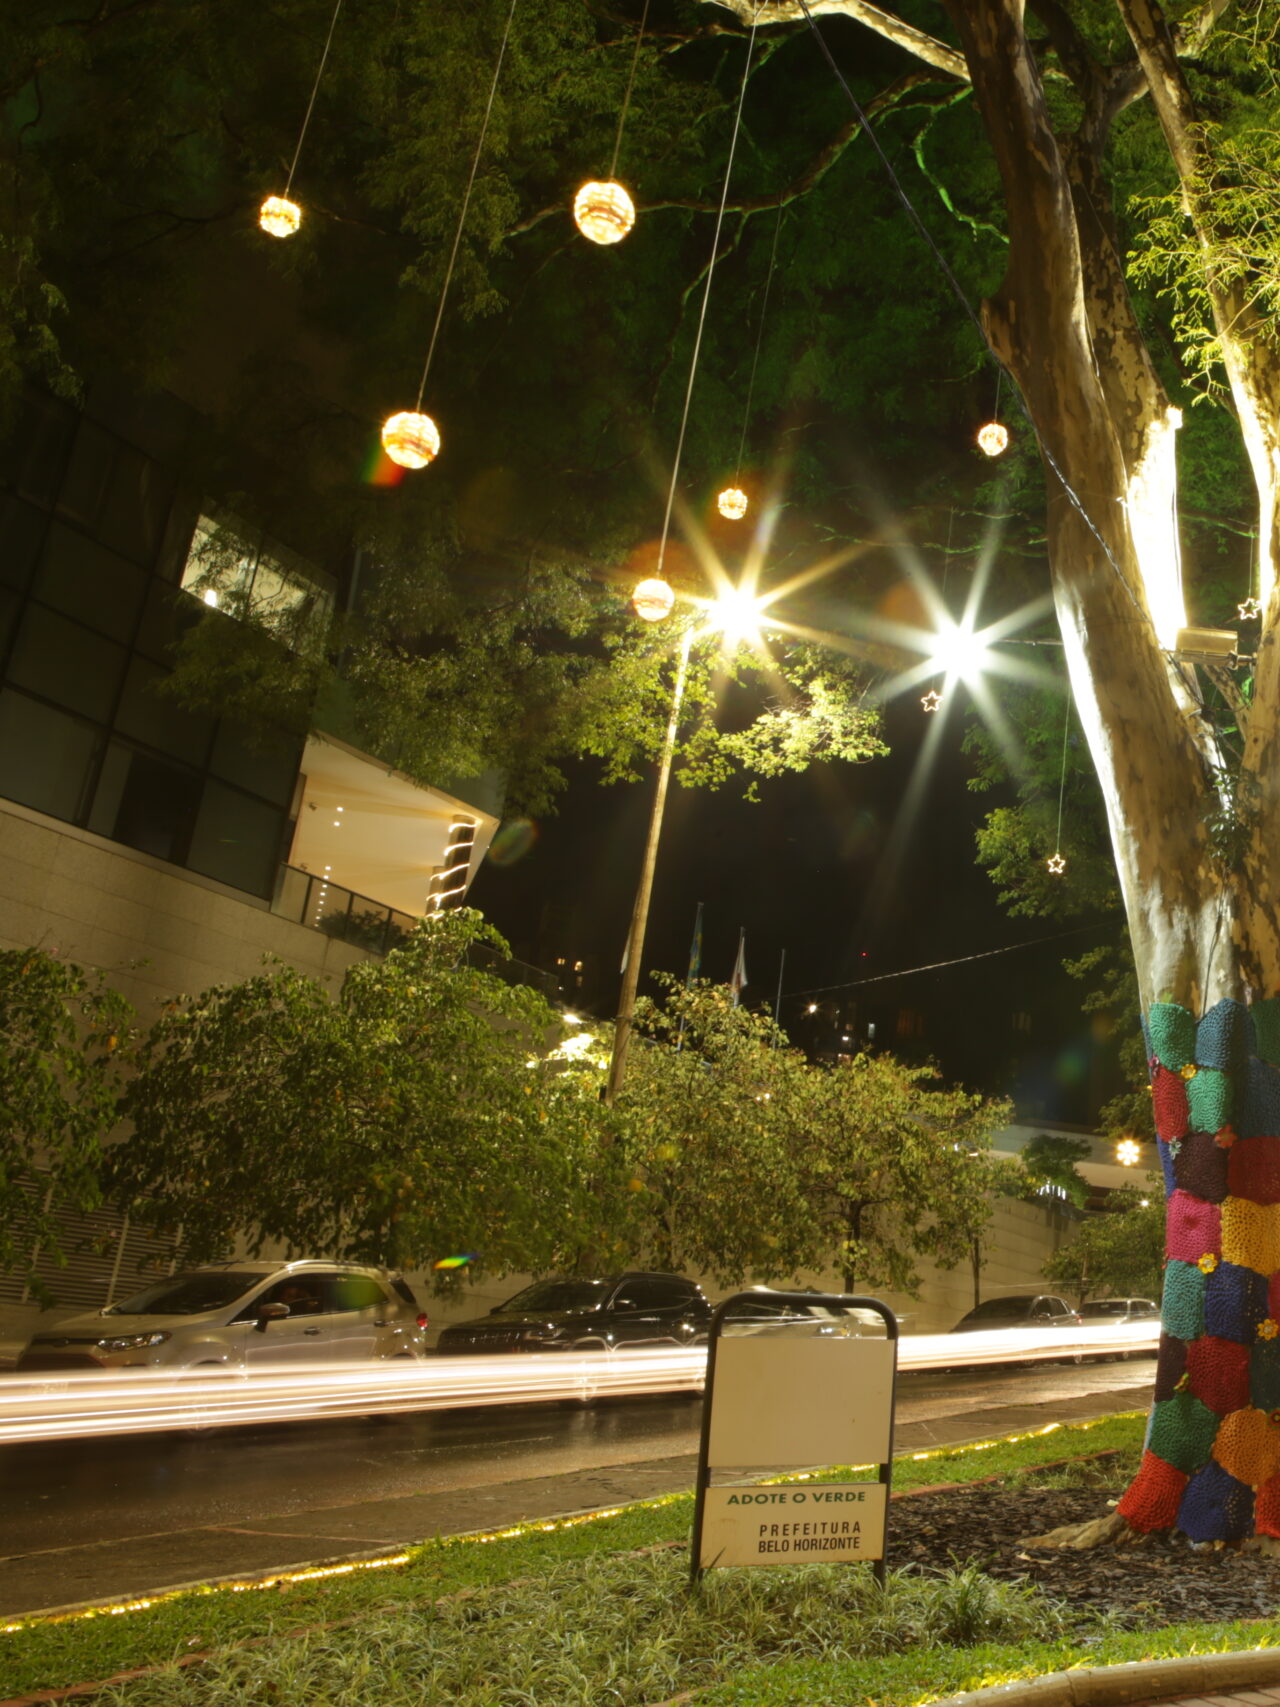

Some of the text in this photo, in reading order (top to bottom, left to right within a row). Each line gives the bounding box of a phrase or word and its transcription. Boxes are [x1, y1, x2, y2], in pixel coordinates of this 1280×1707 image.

[727, 1491, 866, 1505] ADOTE O VERDE
[760, 1521, 861, 1537] PREFEITURA
[758, 1537, 860, 1553] BELO HORIZONTE
